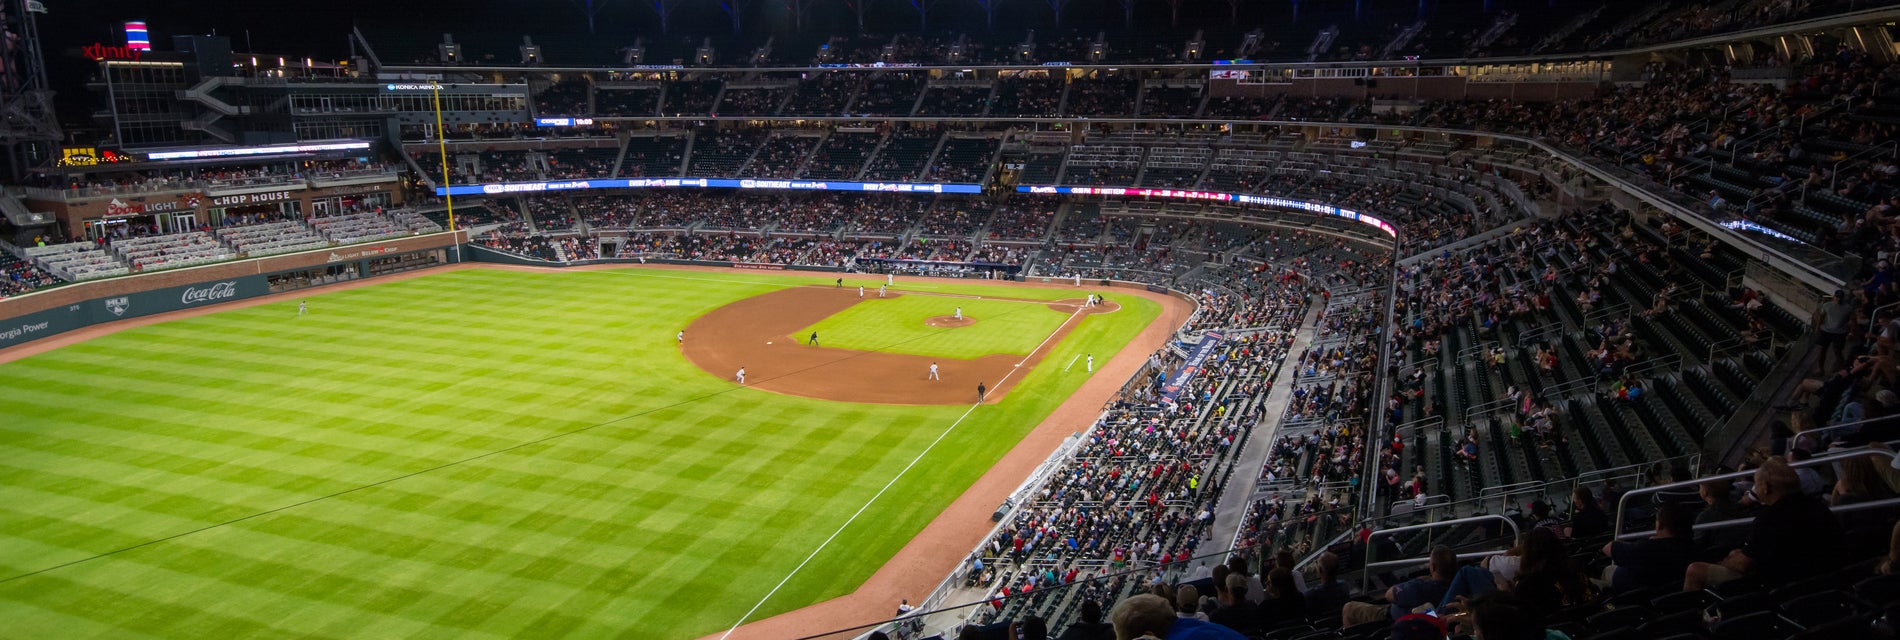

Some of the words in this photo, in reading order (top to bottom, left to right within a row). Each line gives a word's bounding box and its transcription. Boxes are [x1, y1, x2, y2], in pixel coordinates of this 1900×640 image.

[82, 42, 141, 62] xfinity
[504, 183, 547, 192] SOUTHEAST
[214, 195, 247, 206] CHOP
[251, 191, 290, 202] HOUSE
[144, 202, 177, 212] LIGHT
[182, 281, 238, 304] Coca-Cola
[22, 321, 49, 334] Power
